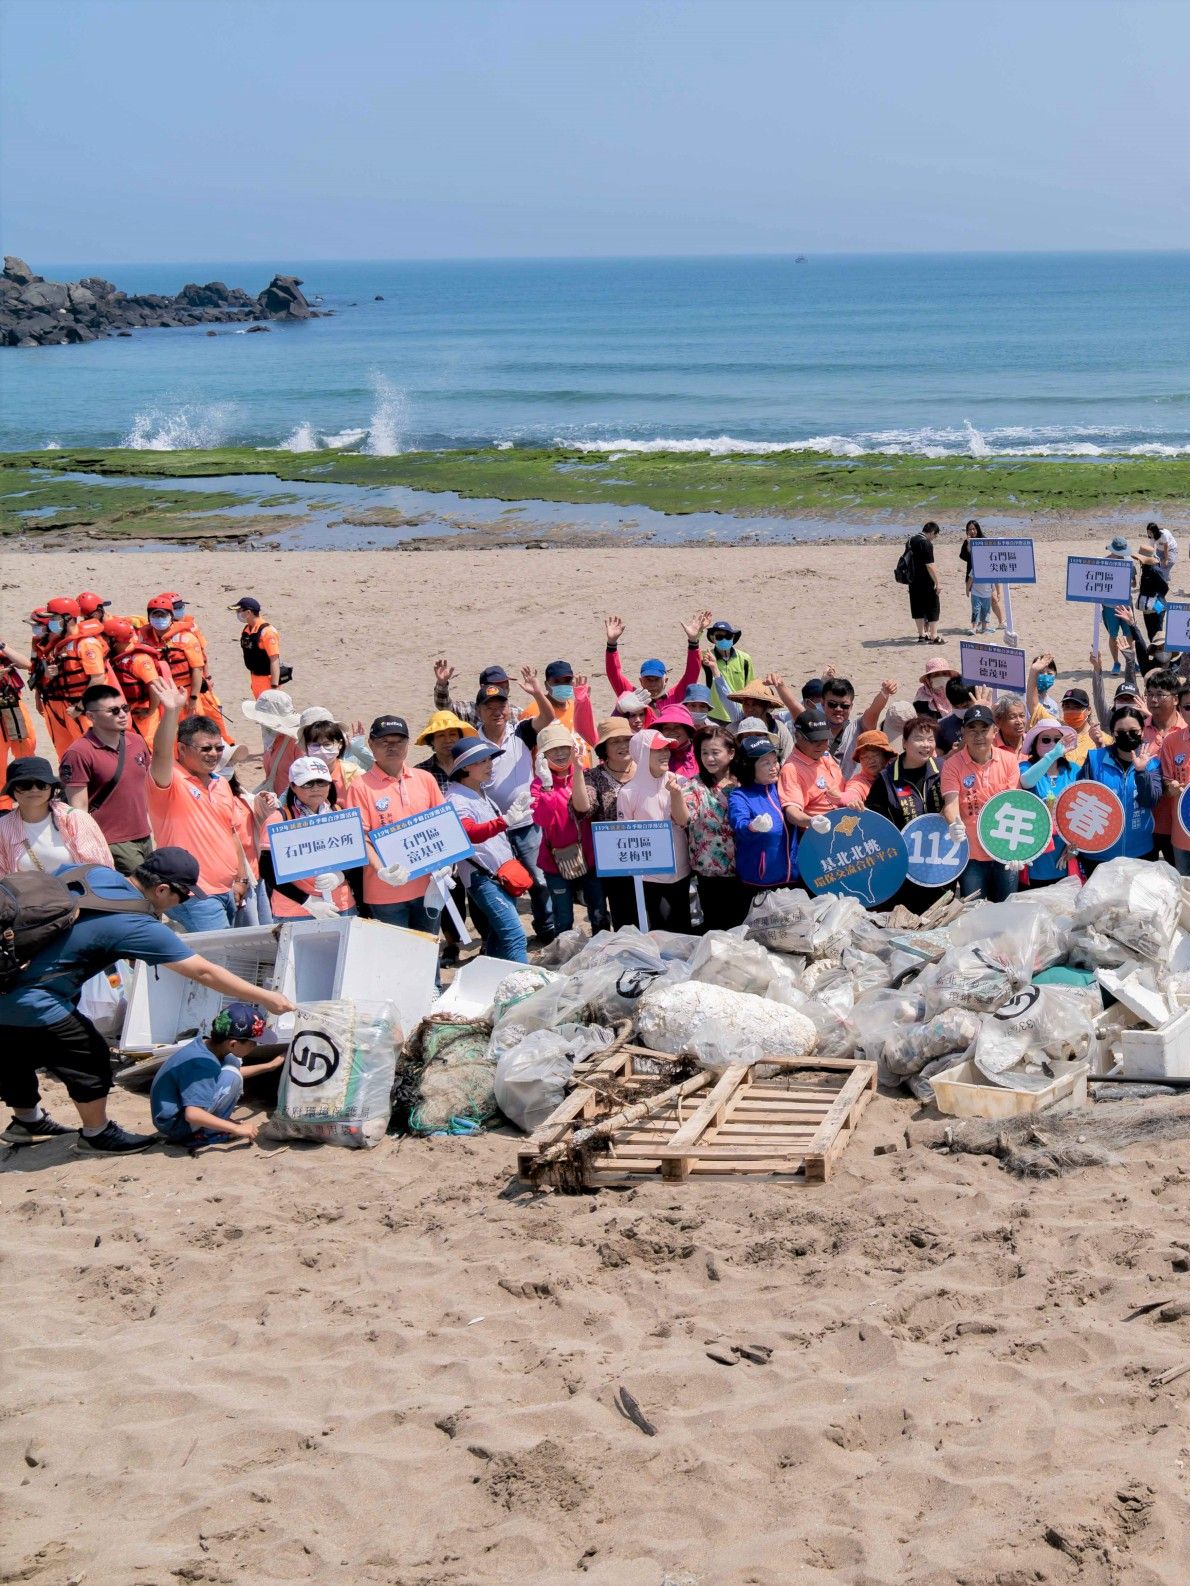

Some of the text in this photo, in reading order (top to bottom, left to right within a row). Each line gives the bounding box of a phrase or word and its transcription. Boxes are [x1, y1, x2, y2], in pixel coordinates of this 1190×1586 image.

[989, 551, 1017, 562] 石門區
[1085, 570, 1114, 582] 石門區
[1085, 581, 1113, 593] 石門里
[979, 656, 1008, 668] 石門區
[989, 802, 1037, 851] 年
[1065, 790, 1113, 841] 春
[284, 832, 354, 859] 石門區公所
[402, 828, 440, 850] 石門區
[617, 836, 652, 849] 石門區
[908, 830, 962, 866] 112
[406, 840, 445, 864] 富基里
[618, 850, 653, 863] 老梅里
[819, 838, 882, 873] 基北北桃
